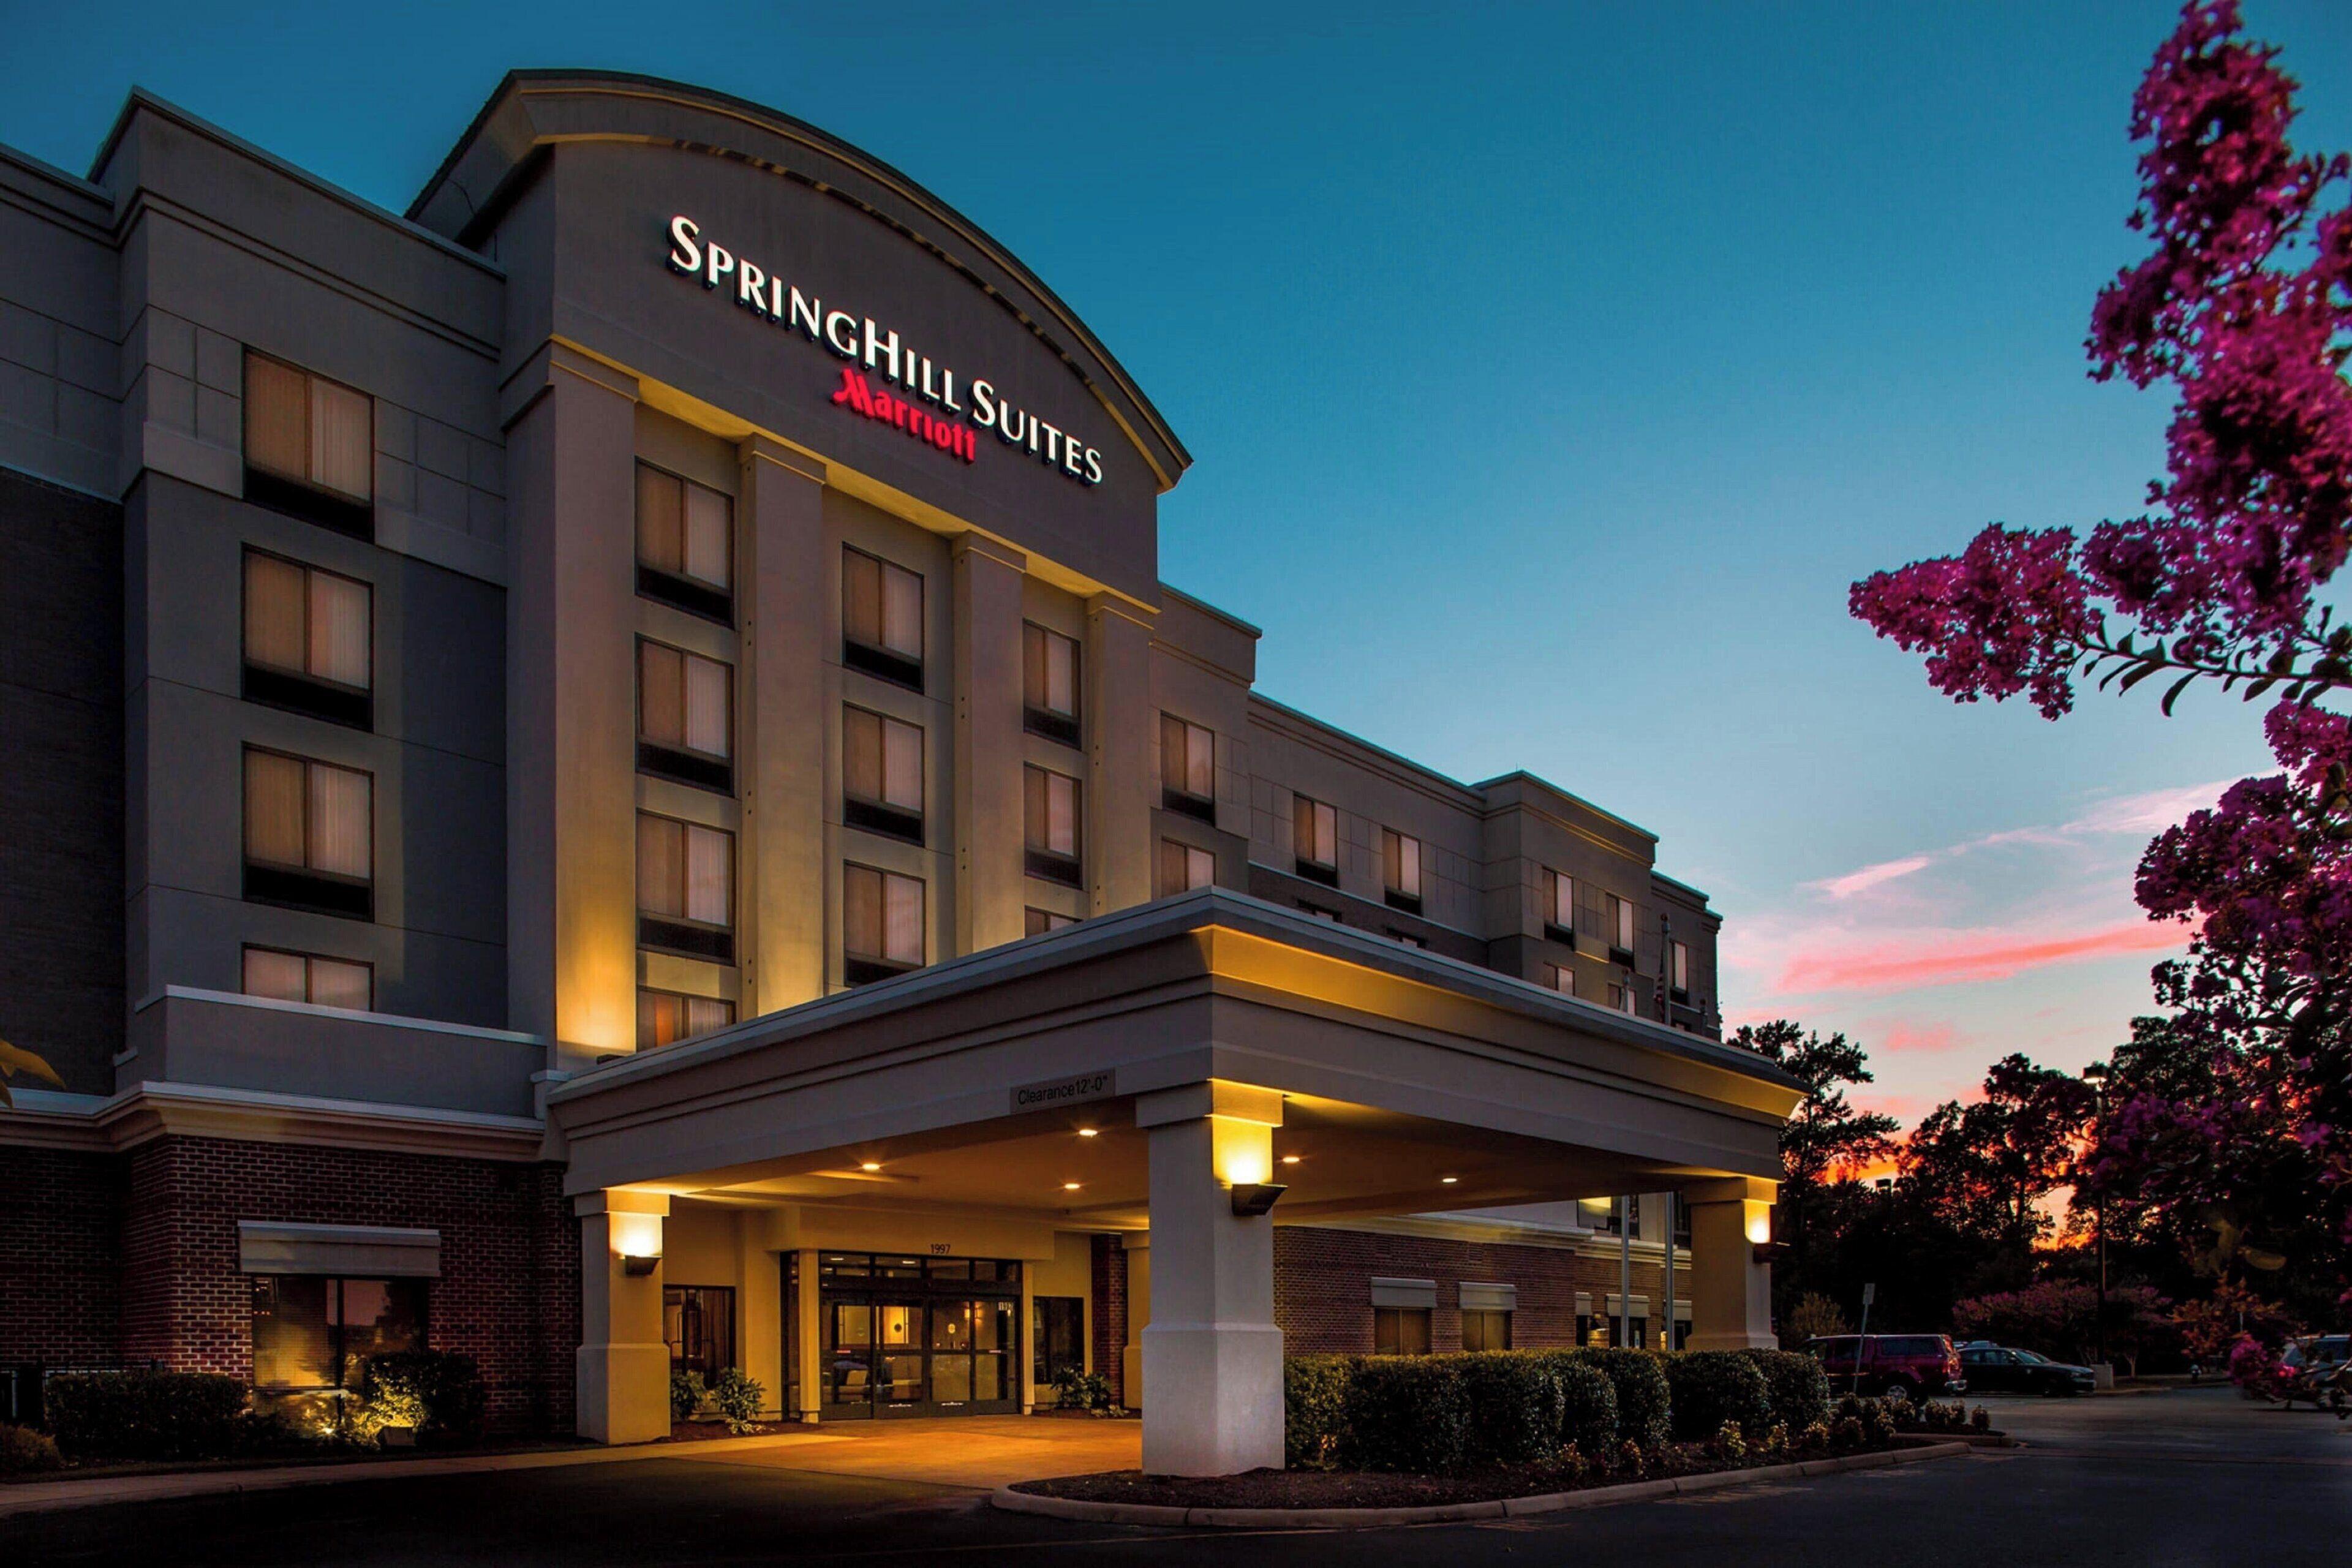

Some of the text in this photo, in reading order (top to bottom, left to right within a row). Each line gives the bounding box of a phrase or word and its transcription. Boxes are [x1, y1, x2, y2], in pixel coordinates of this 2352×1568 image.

[832, 366, 977, 462] Marriott
[972, 379, 1103, 483] SUITES
[1017, 1084, 1073, 1105] Clearance
[931, 1243, 951, 1254] 1997
